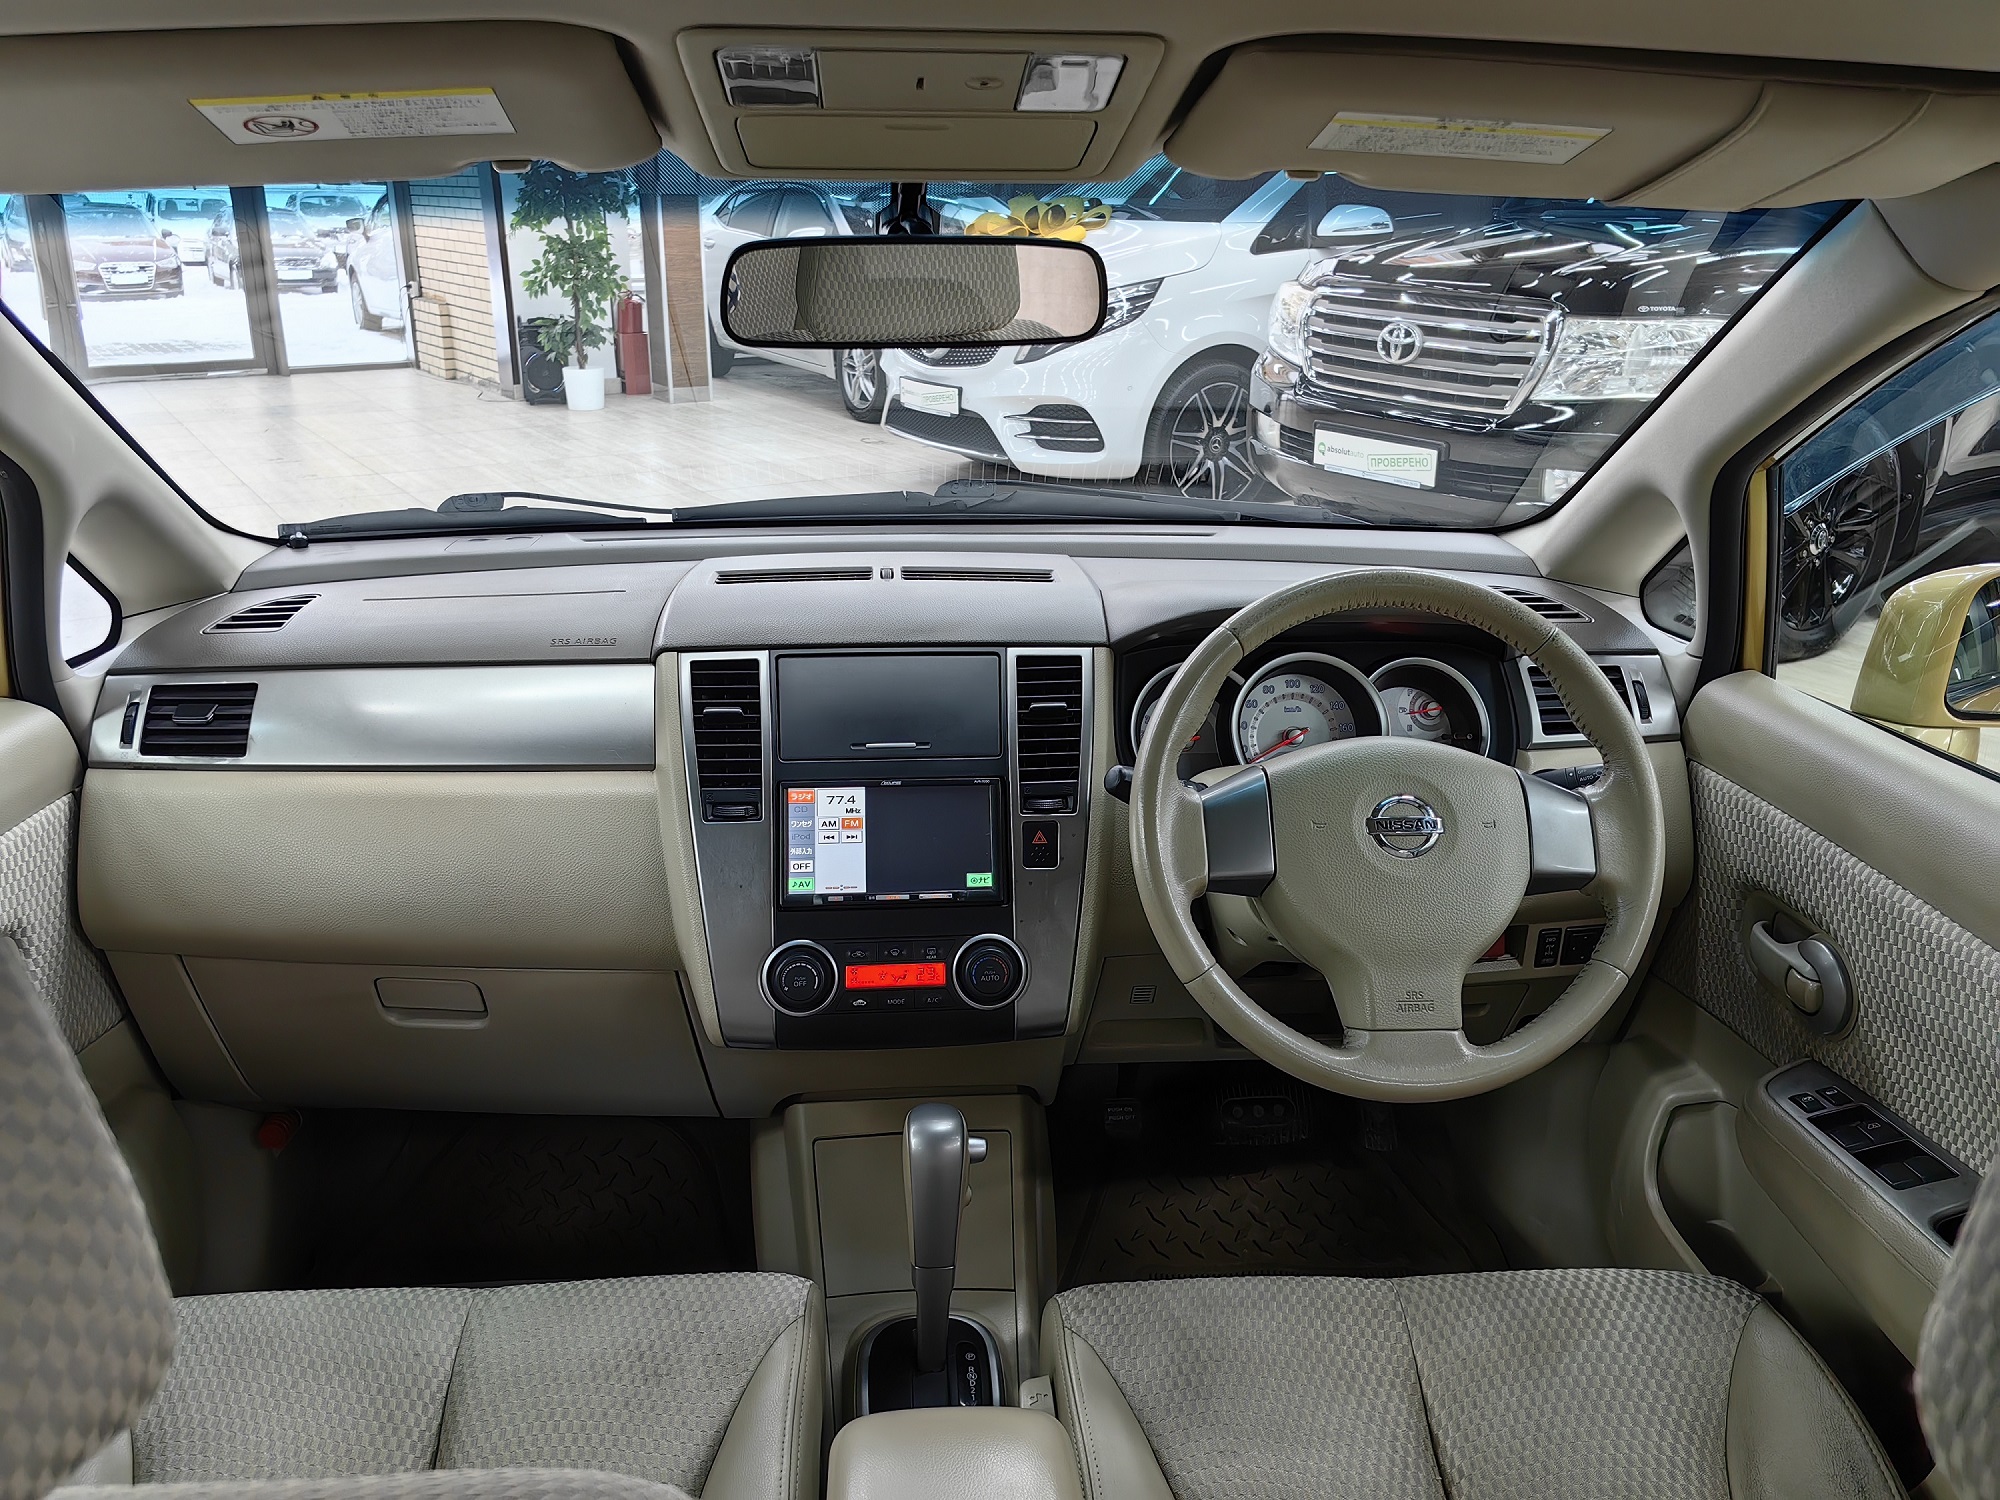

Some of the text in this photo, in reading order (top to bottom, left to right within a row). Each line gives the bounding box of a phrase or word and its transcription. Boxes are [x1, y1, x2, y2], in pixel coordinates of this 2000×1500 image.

[1327, 446, 1364, 459] absolutauto
[1370, 457, 1429, 468] ПРОВЕРЕНО
[1285, 679, 1301, 688] 100
[1262, 685, 1275, 694] 80
[1310, 684, 1325, 693] 120
[1245, 699, 1259, 709] 60
[1329, 702, 1345, 710] 140
[1579, 774, 1594, 782] AUTO
[826, 795, 856, 805] 77.4
[790, 820, 813, 828] ワンセグ
[821, 820, 837, 828] AM
[844, 819, 859, 827] FM
[1376, 821, 1437, 831] NISSAN
[792, 862, 811, 871] OFF
[1405, 991, 1424, 1000] SRS
[1396, 1003, 1435, 1013] AIRBAG
